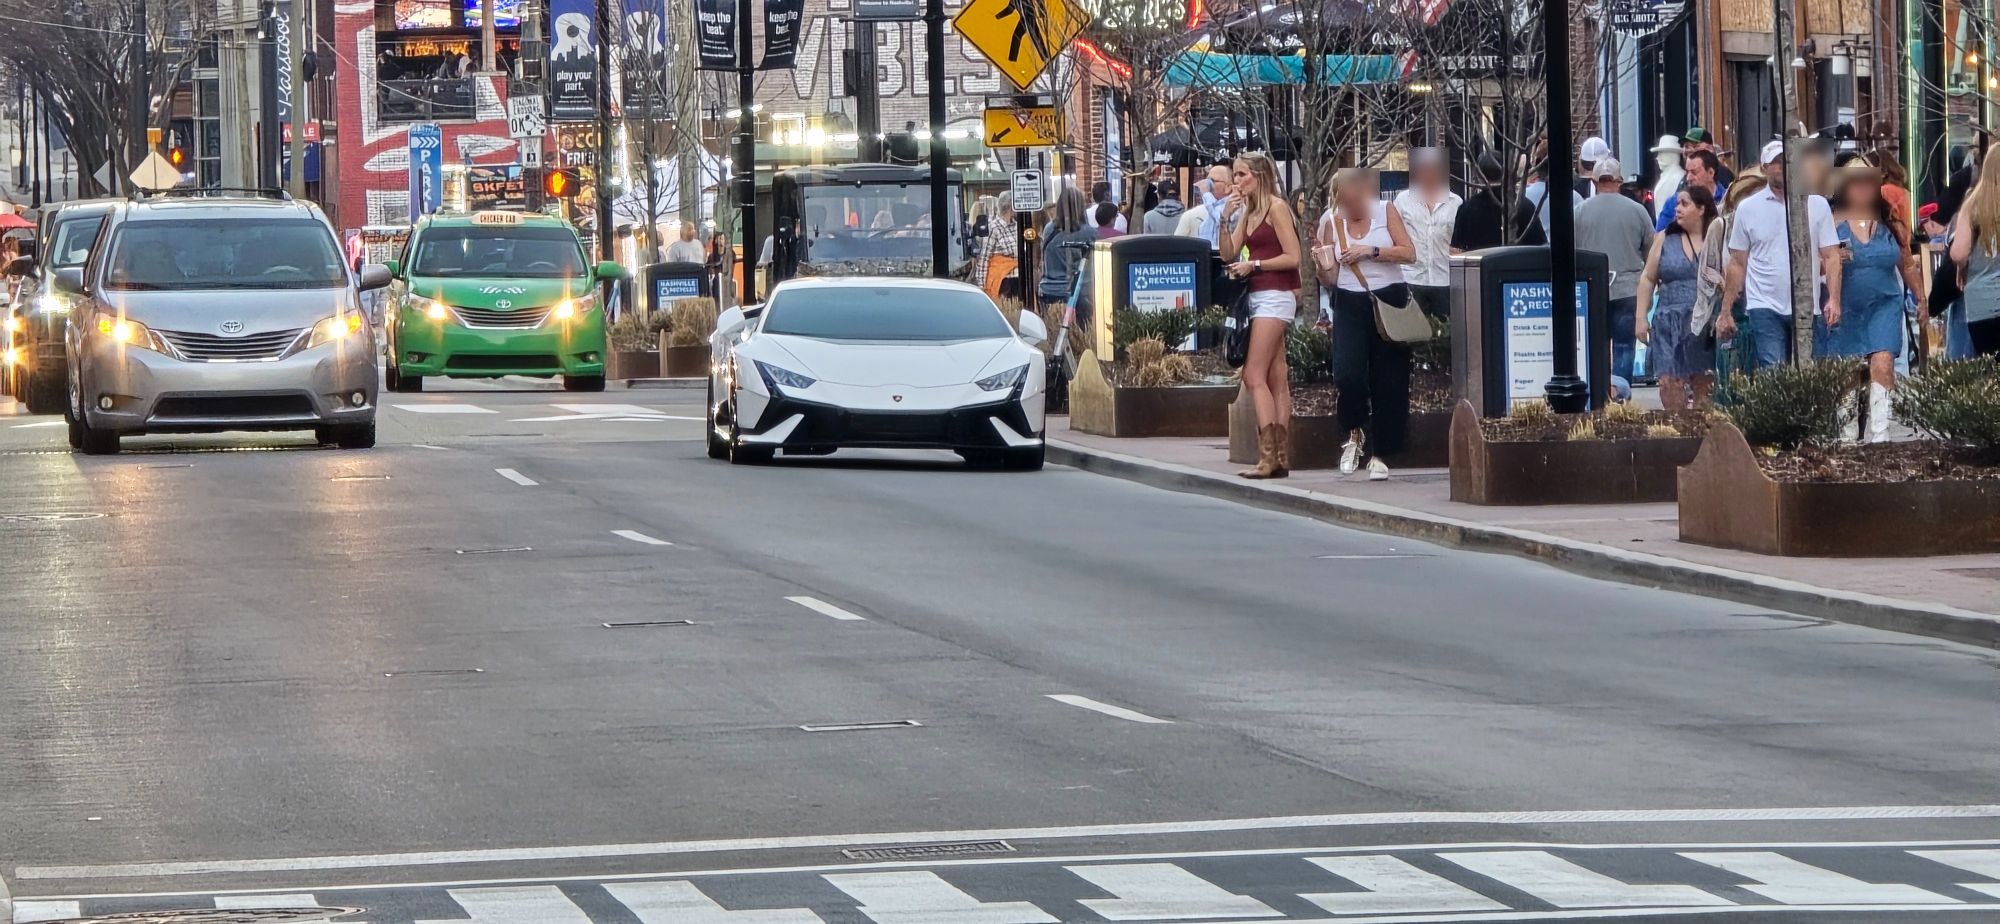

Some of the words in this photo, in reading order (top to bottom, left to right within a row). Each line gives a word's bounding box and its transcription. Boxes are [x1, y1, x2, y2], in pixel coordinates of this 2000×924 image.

[717, 11, 731, 24] the
[706, 23, 725, 36] beat.
[794, 17, 1001, 97] VIBES
[557, 70, 573, 82] play
[574, 71, 592, 82] your
[565, 82, 584, 93] part.
[511, 118, 526, 133] OK
[480, 214, 503, 223] CHECKER
[505, 214, 516, 223] CAB
[1134, 265, 1191, 275] NASHVILLE
[1148, 276, 1191, 285] RECYCLES
[1510, 286, 1582, 299] NASHVE
